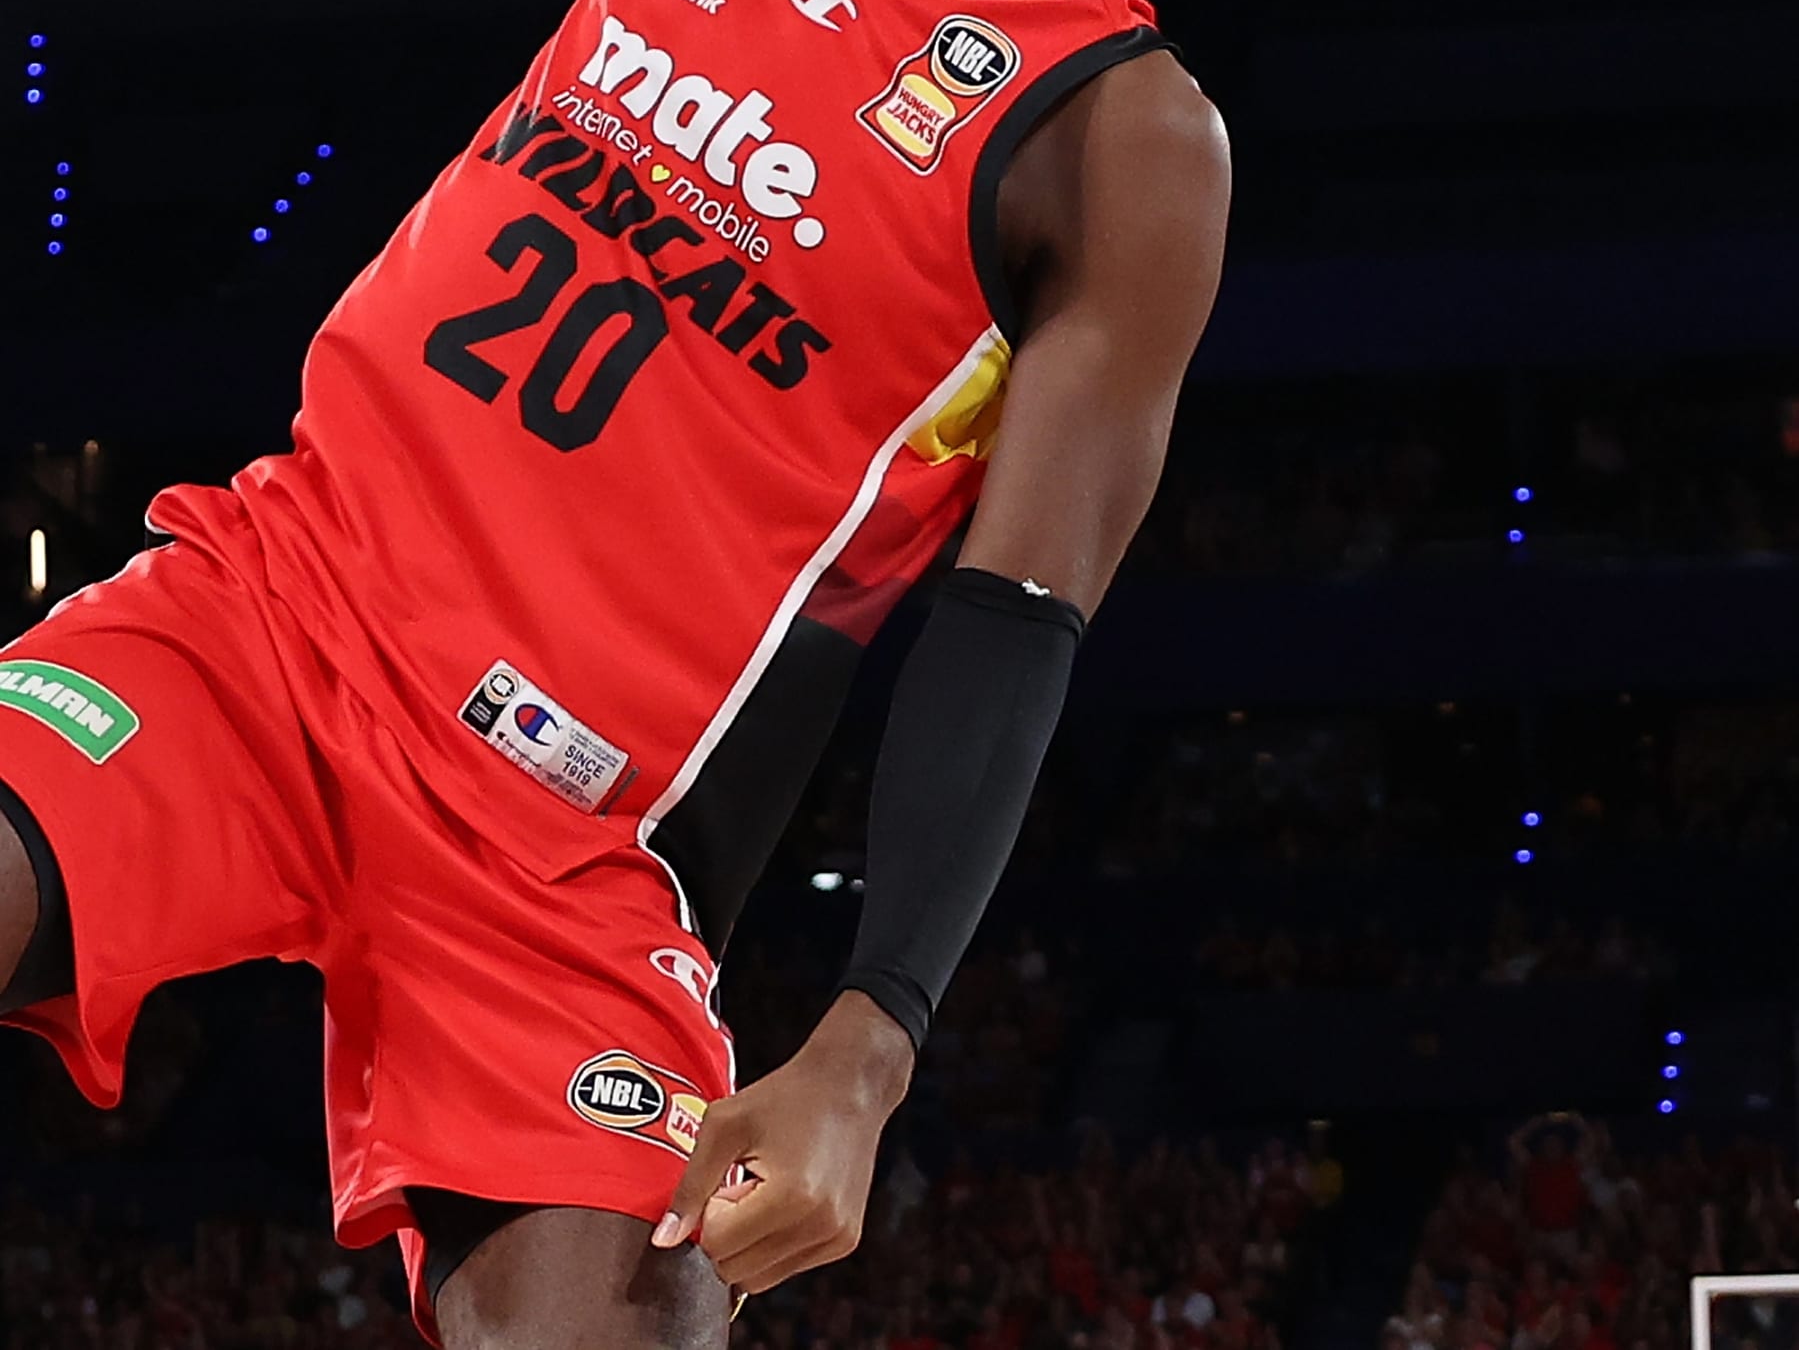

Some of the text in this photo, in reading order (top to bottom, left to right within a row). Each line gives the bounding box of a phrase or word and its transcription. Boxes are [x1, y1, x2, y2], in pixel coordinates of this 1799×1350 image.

[943, 30, 996, 82] NBL
[898, 87, 945, 126] HUNGRY
[552, 86, 770, 263] internet mobile
[423, 213, 670, 453] 20
[562, 761, 592, 787] 1919
[564, 744, 606, 780] SINCE
[590, 1074, 644, 1112] NBL
